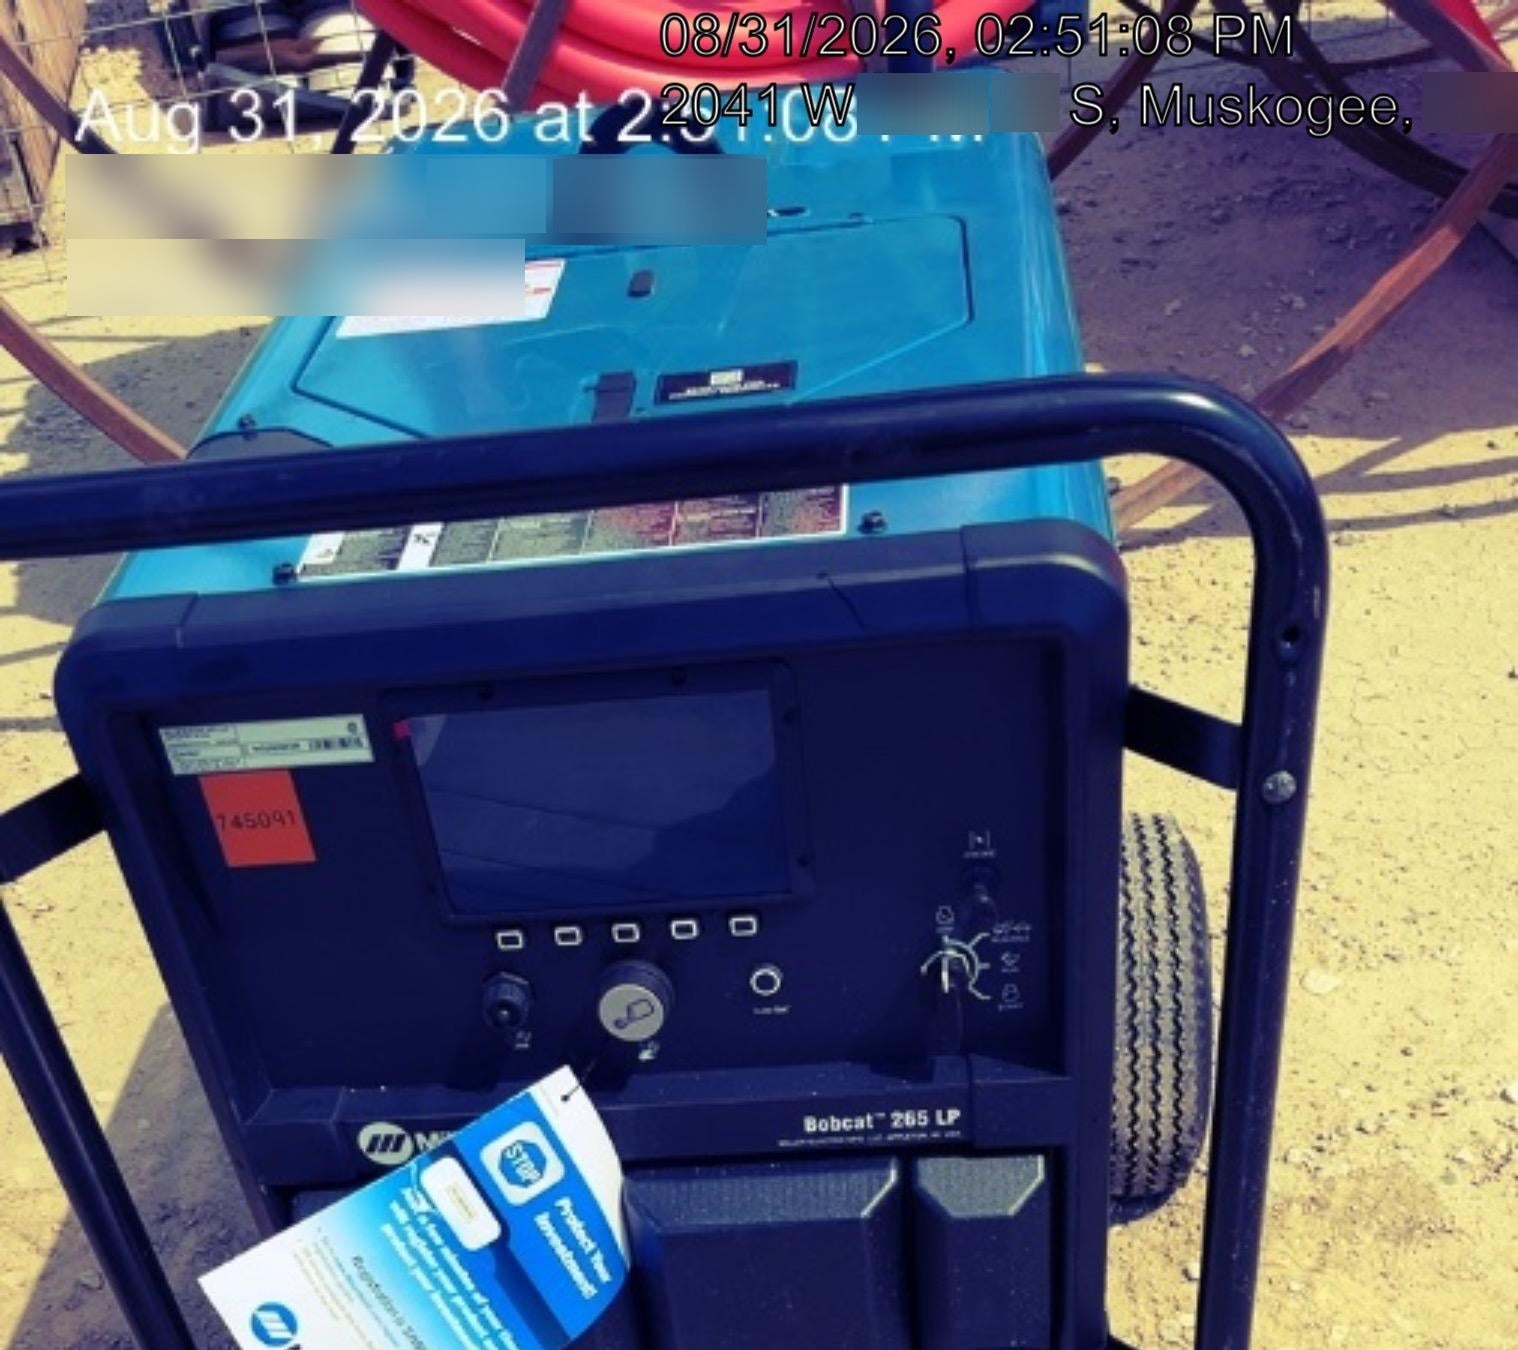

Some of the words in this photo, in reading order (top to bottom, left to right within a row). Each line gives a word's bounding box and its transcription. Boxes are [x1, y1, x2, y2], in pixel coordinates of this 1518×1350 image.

[216, 809, 296, 832] 745091
[890, 1109, 930, 1129] 265
[935, 1108, 961, 1127] LP
[553, 1195, 598, 1254] Protect
